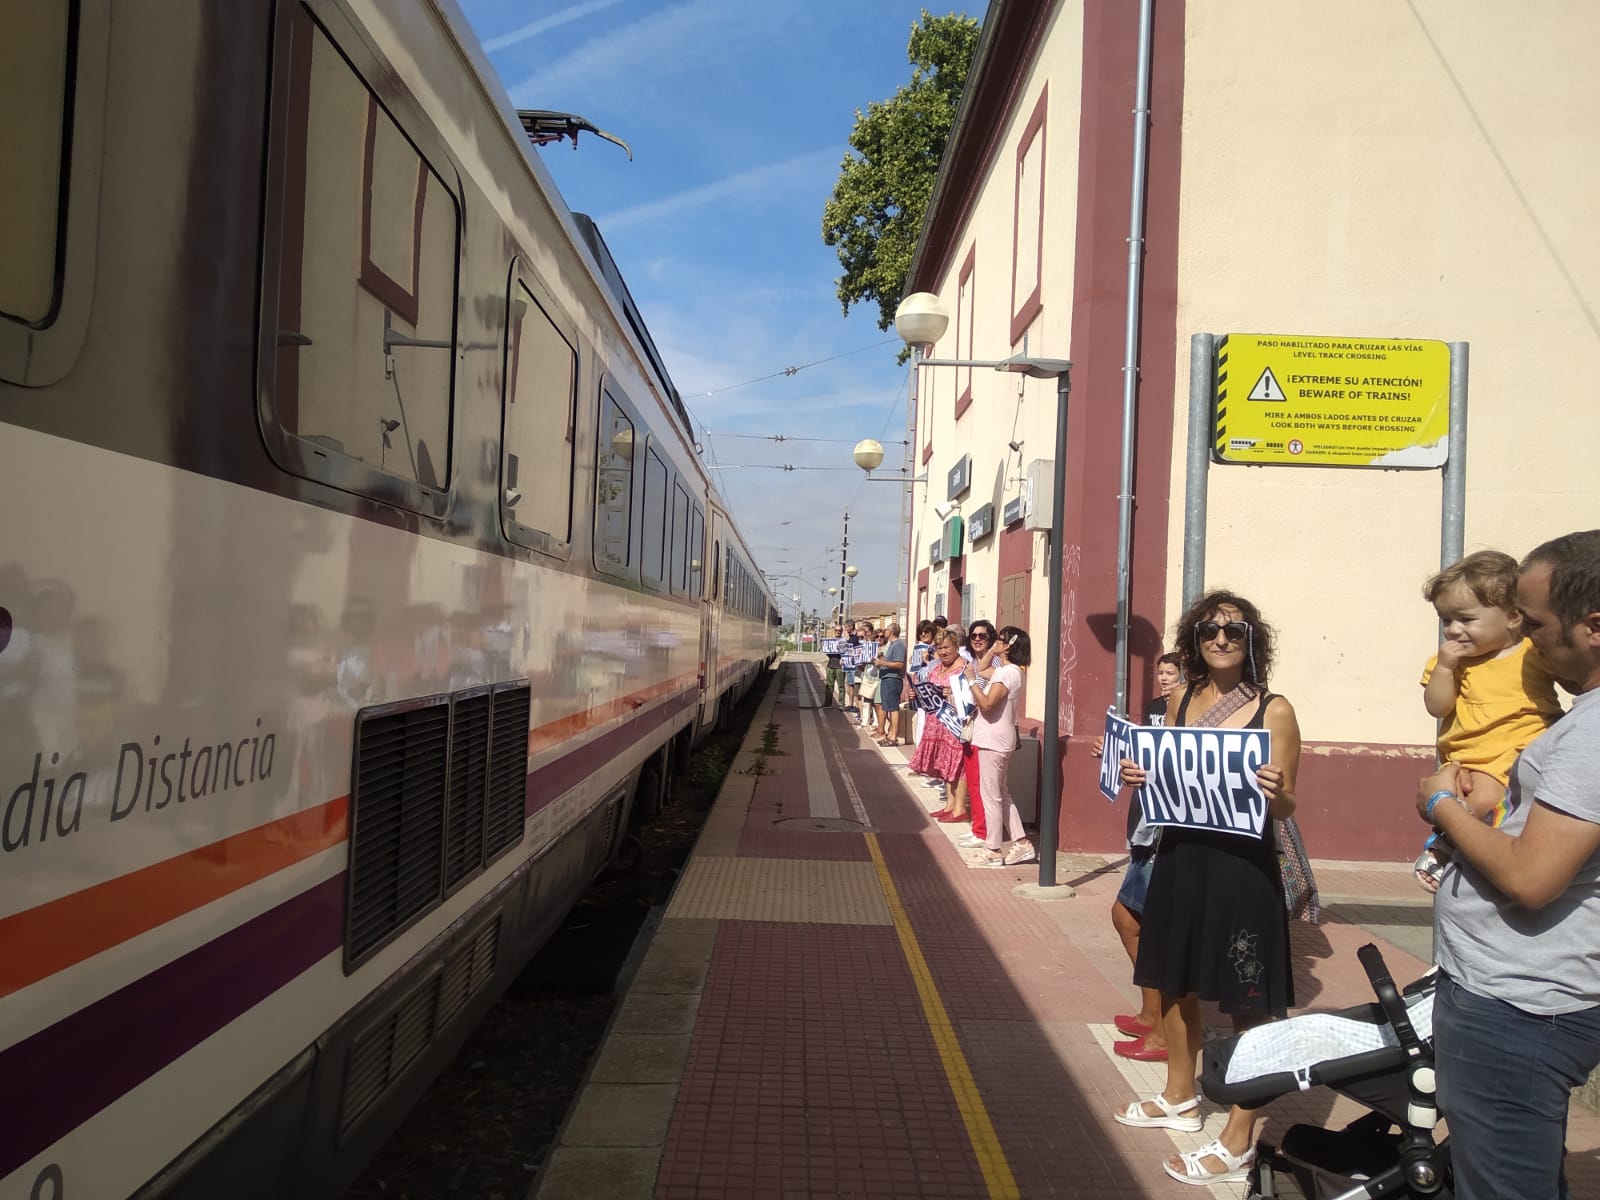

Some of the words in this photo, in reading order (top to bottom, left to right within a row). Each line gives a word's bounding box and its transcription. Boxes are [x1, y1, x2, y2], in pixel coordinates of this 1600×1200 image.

[1257, 340, 1278, 348] PASO
[1280, 341, 1329, 349] HABILITADO
[1332, 342, 1352, 350] PARA
[1354, 343, 1386, 351] CRUZAR
[1404, 343, 1423, 352] VÍAS
[1293, 351, 1316, 359] LEVEL
[1319, 352, 1344, 360] TRACK
[1346, 353, 1387, 361] CROSSING
[1287, 374, 1341, 385] ¡EXTREME
[1344, 376, 1359, 385] SU
[1362, 376, 1423, 387] ATENCIÓN!
[1299, 388, 1345, 399] BEWARE
[1348, 391, 1362, 400] OF
[1365, 391, 1411, 401] TRAINS!
[1294, 412, 1322, 420] AMBOS
[1390, 415, 1423, 423] CRUZAR
[1294, 422, 1316, 430] BOTH
[1342, 423, 1373, 431] BEFORE
[1374, 424, 1416, 433] CROSSING
[0, 752, 88, 853] dia
[110, 718, 277, 823] Distancia
[1136, 730, 1266, 835] ROBRES
